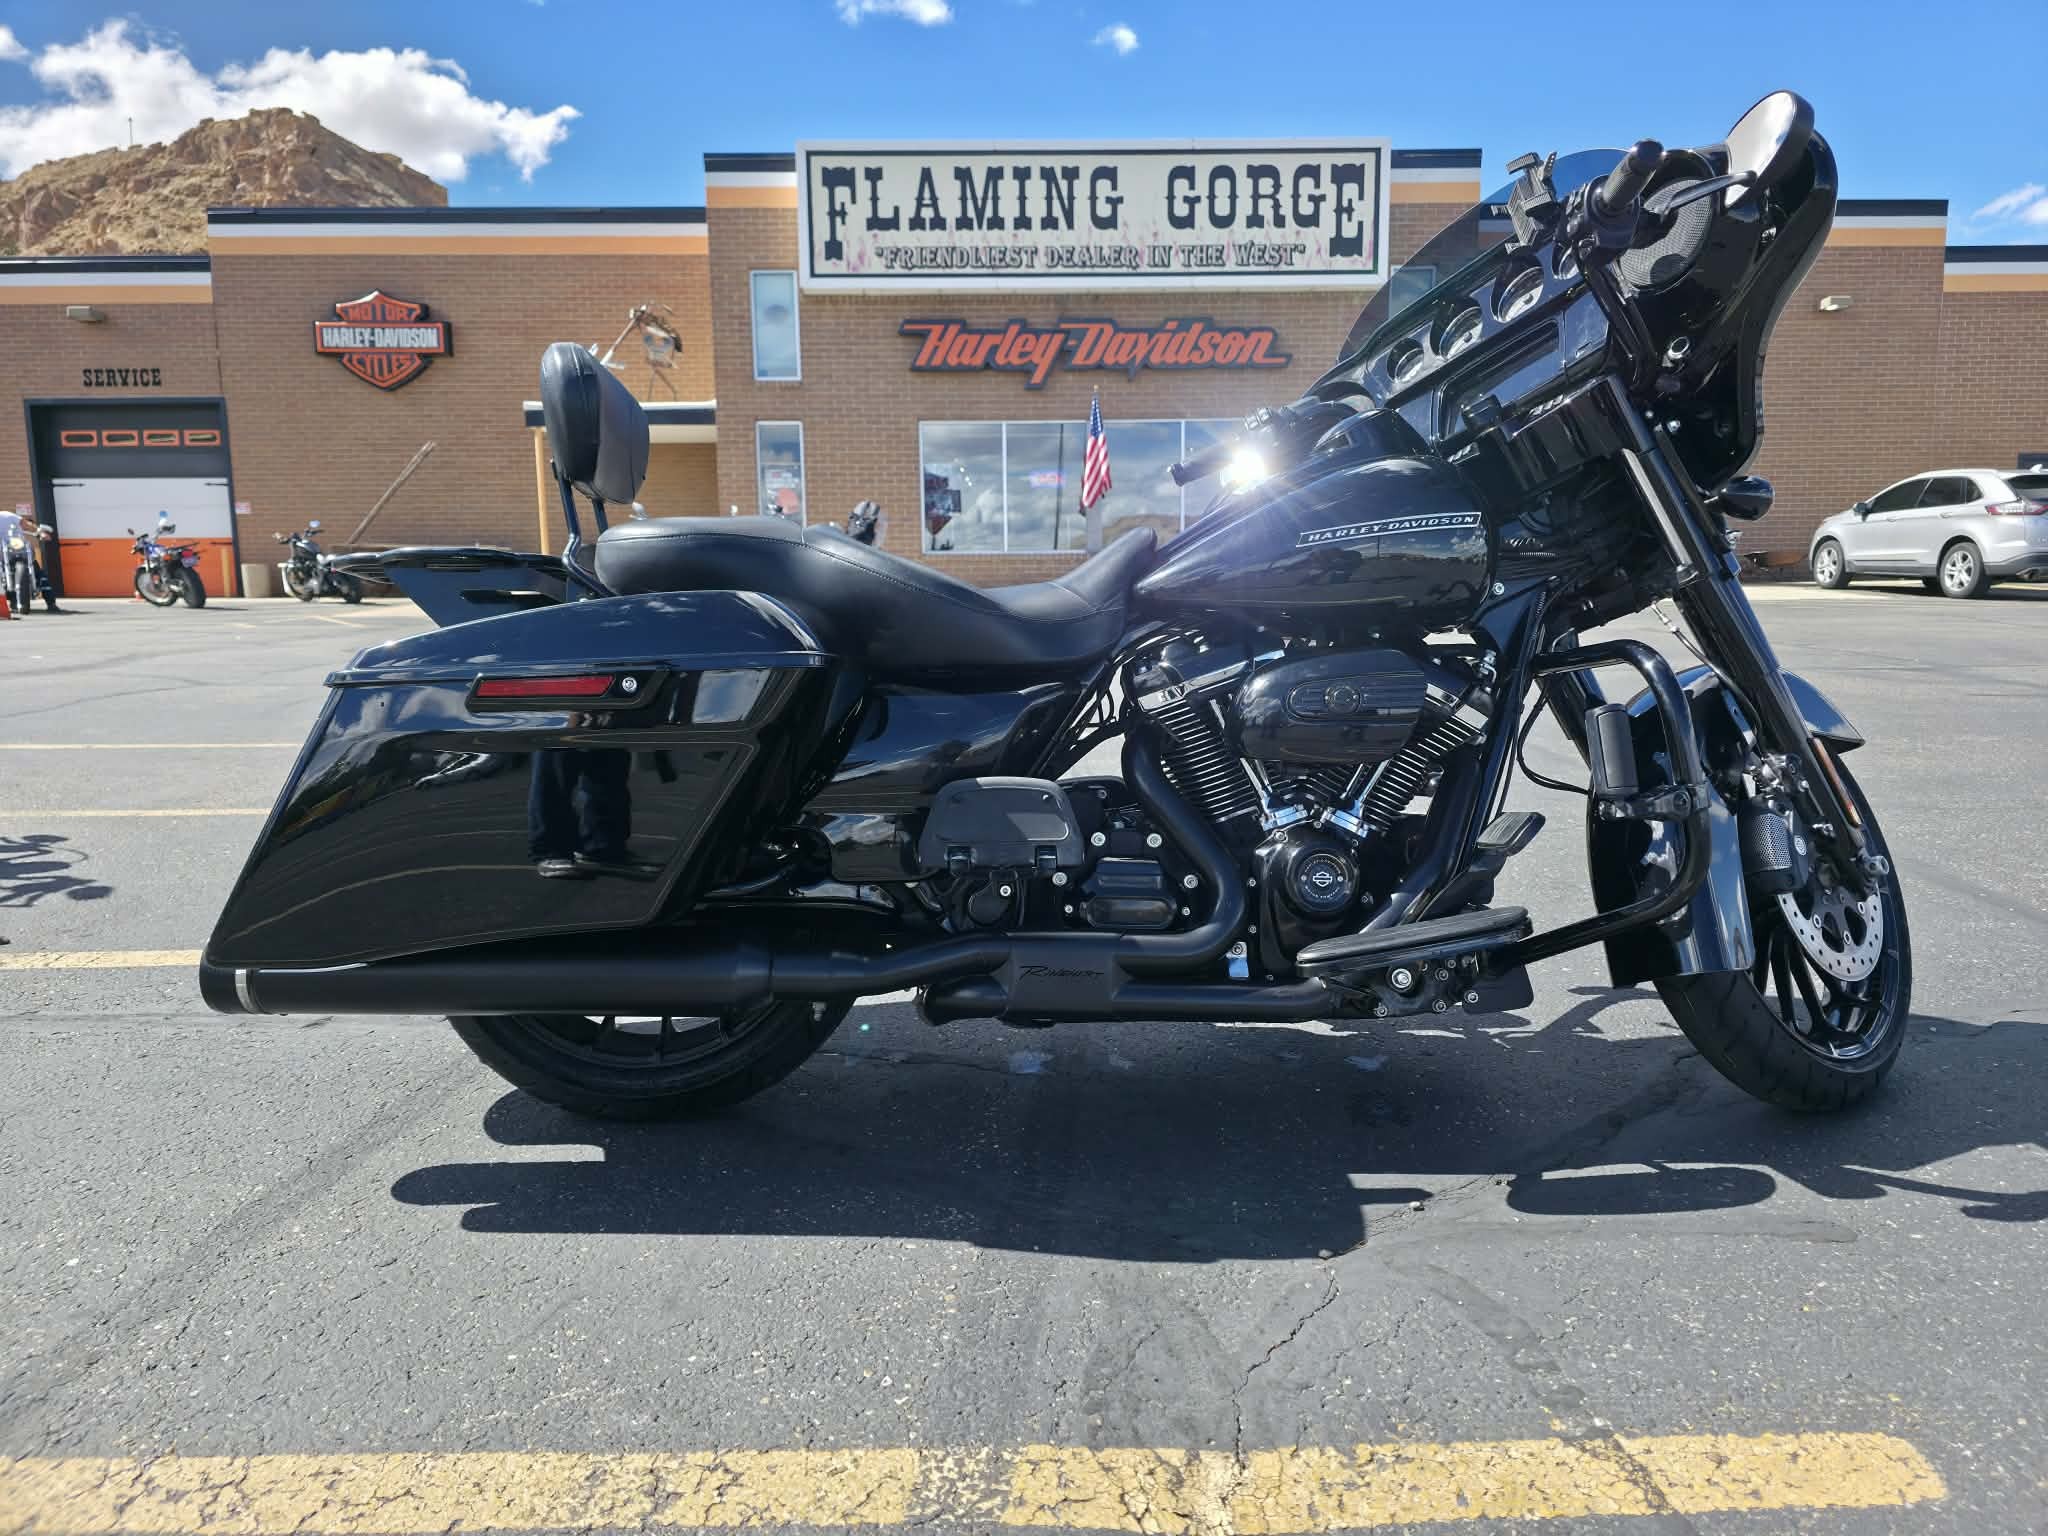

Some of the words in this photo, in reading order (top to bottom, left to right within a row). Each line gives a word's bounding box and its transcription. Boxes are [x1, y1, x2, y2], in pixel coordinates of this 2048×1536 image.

[821, 165, 1124, 261] FLAMING
[1164, 162, 1366, 257] GORGE
[1045, 245, 1140, 270] DEALER
[1147, 245, 1173, 268] IN
[1178, 244, 1226, 268] THE
[322, 327, 439, 348] HARLEY-DAVIDSON
[351, 353, 413, 381] CYCLES
[903, 320, 1288, 387] Harley-Davidson
[82, 367, 162, 388] SERVICE
[1308, 515, 1474, 542] HARLEY-DAVIDSON
